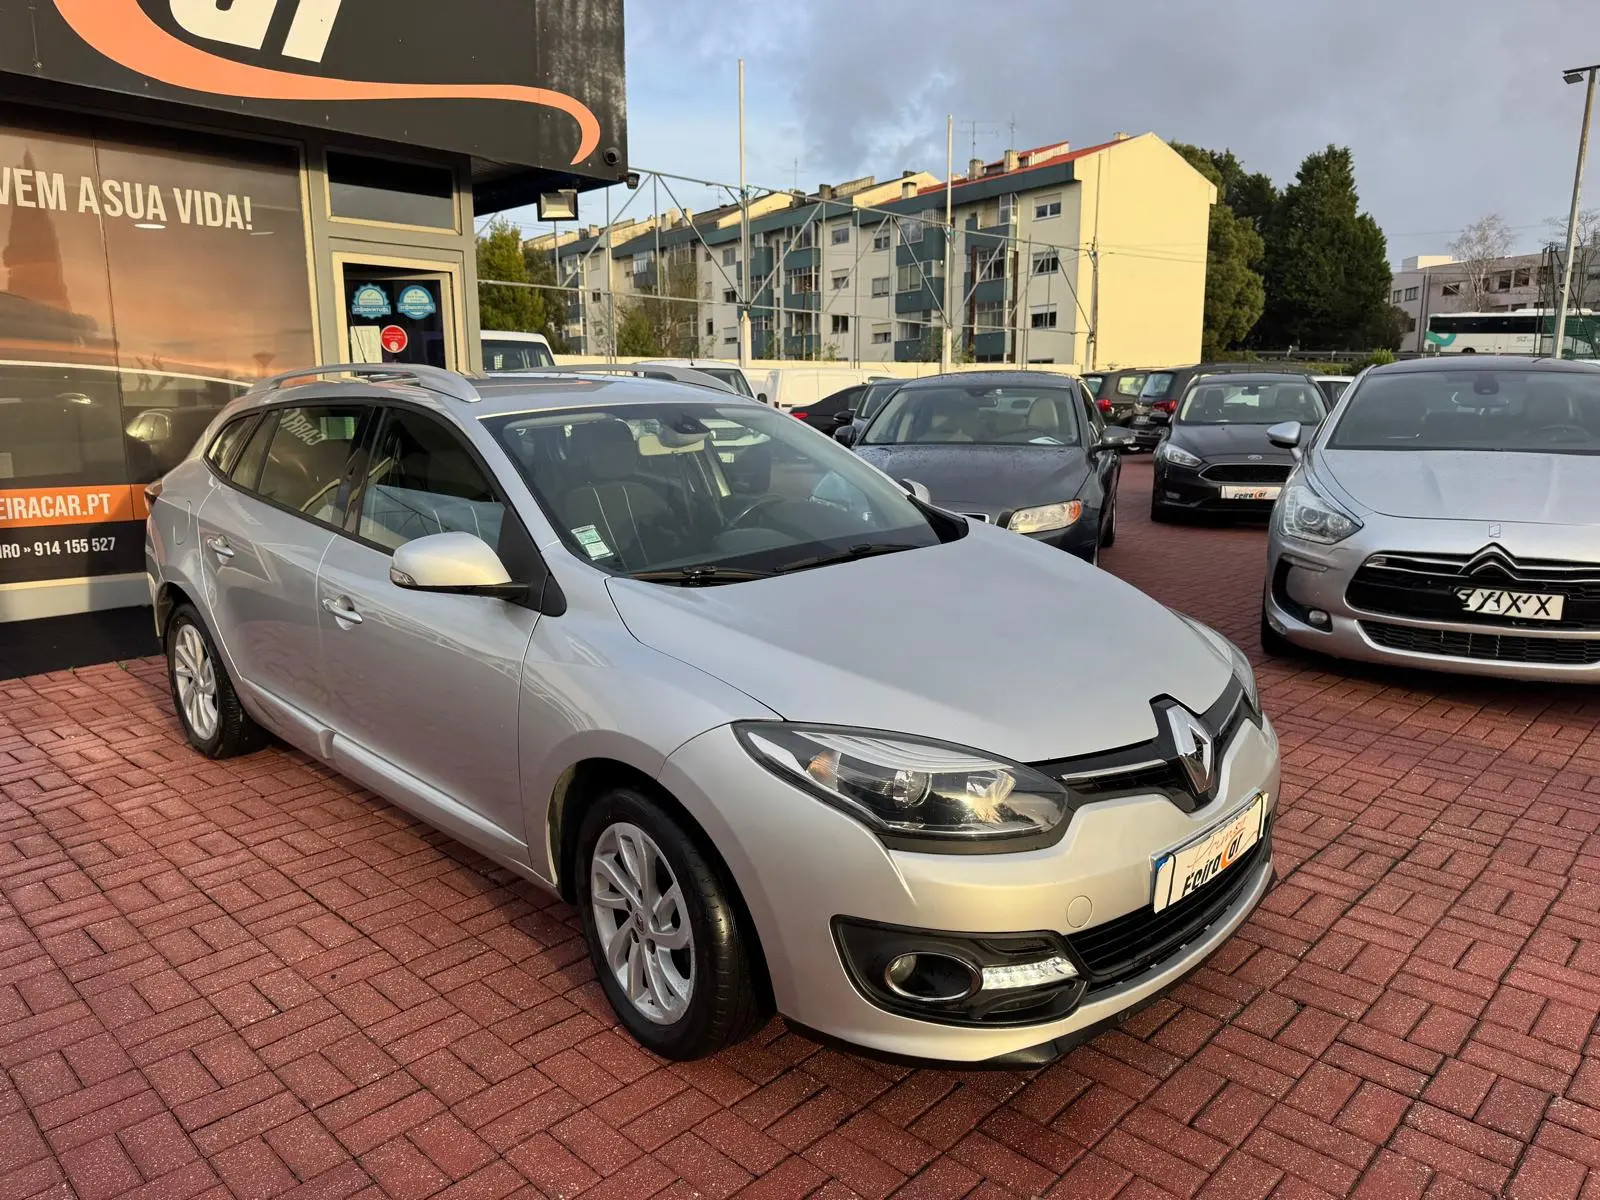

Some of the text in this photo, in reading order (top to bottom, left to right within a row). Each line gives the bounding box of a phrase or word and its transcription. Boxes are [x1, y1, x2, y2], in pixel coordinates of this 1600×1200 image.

[78, 176, 100, 215] A
[102, 179, 168, 222] SUA
[172, 187, 253, 231] VIDA!
[34, 540, 61, 556] 914
[64, 538, 89, 554] 155
[91, 536, 116, 552] 527
